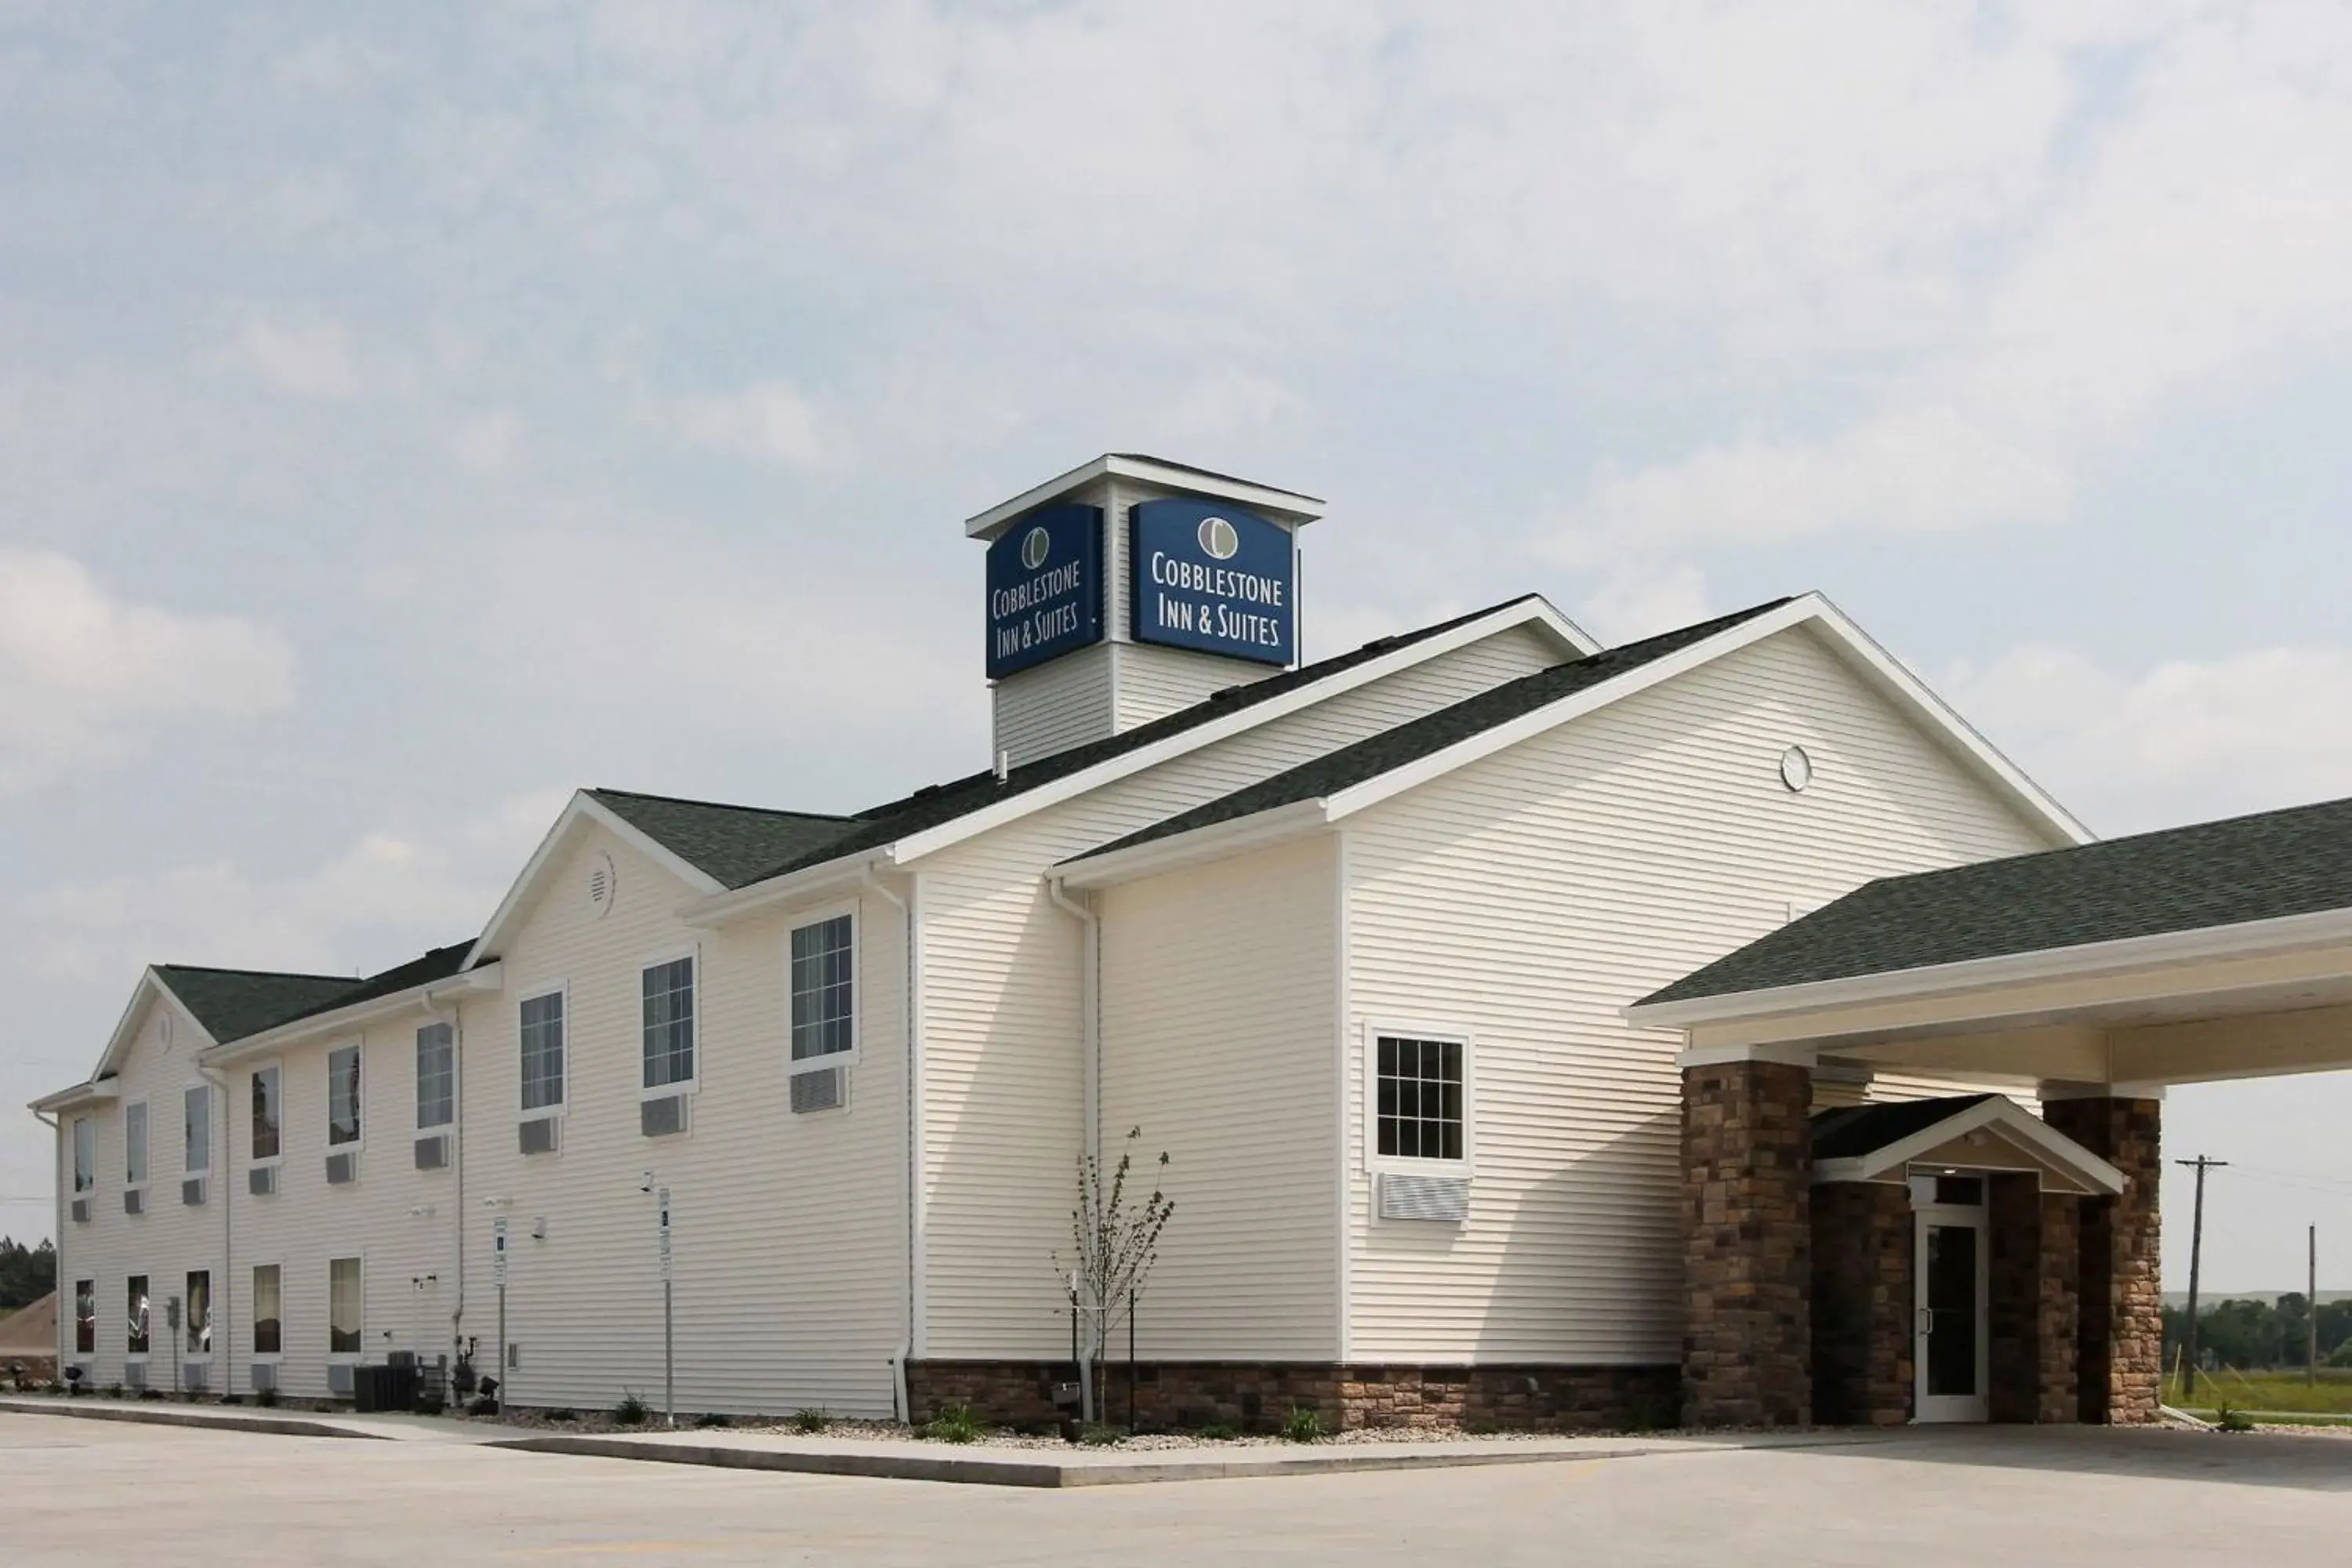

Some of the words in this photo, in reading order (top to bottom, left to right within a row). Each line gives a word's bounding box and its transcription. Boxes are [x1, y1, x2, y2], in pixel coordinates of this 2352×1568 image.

[993, 559, 1080, 620] COBBLESTONE
[1152, 551, 1283, 607] COBBLESTONE
[996, 625, 1019, 659] INN
[1022, 619, 1033, 649] &
[1035, 601, 1078, 644] SUITES
[1159, 592, 1192, 631] INN
[1198, 604, 1212, 636] &
[1218, 603, 1279, 648] SUITES
